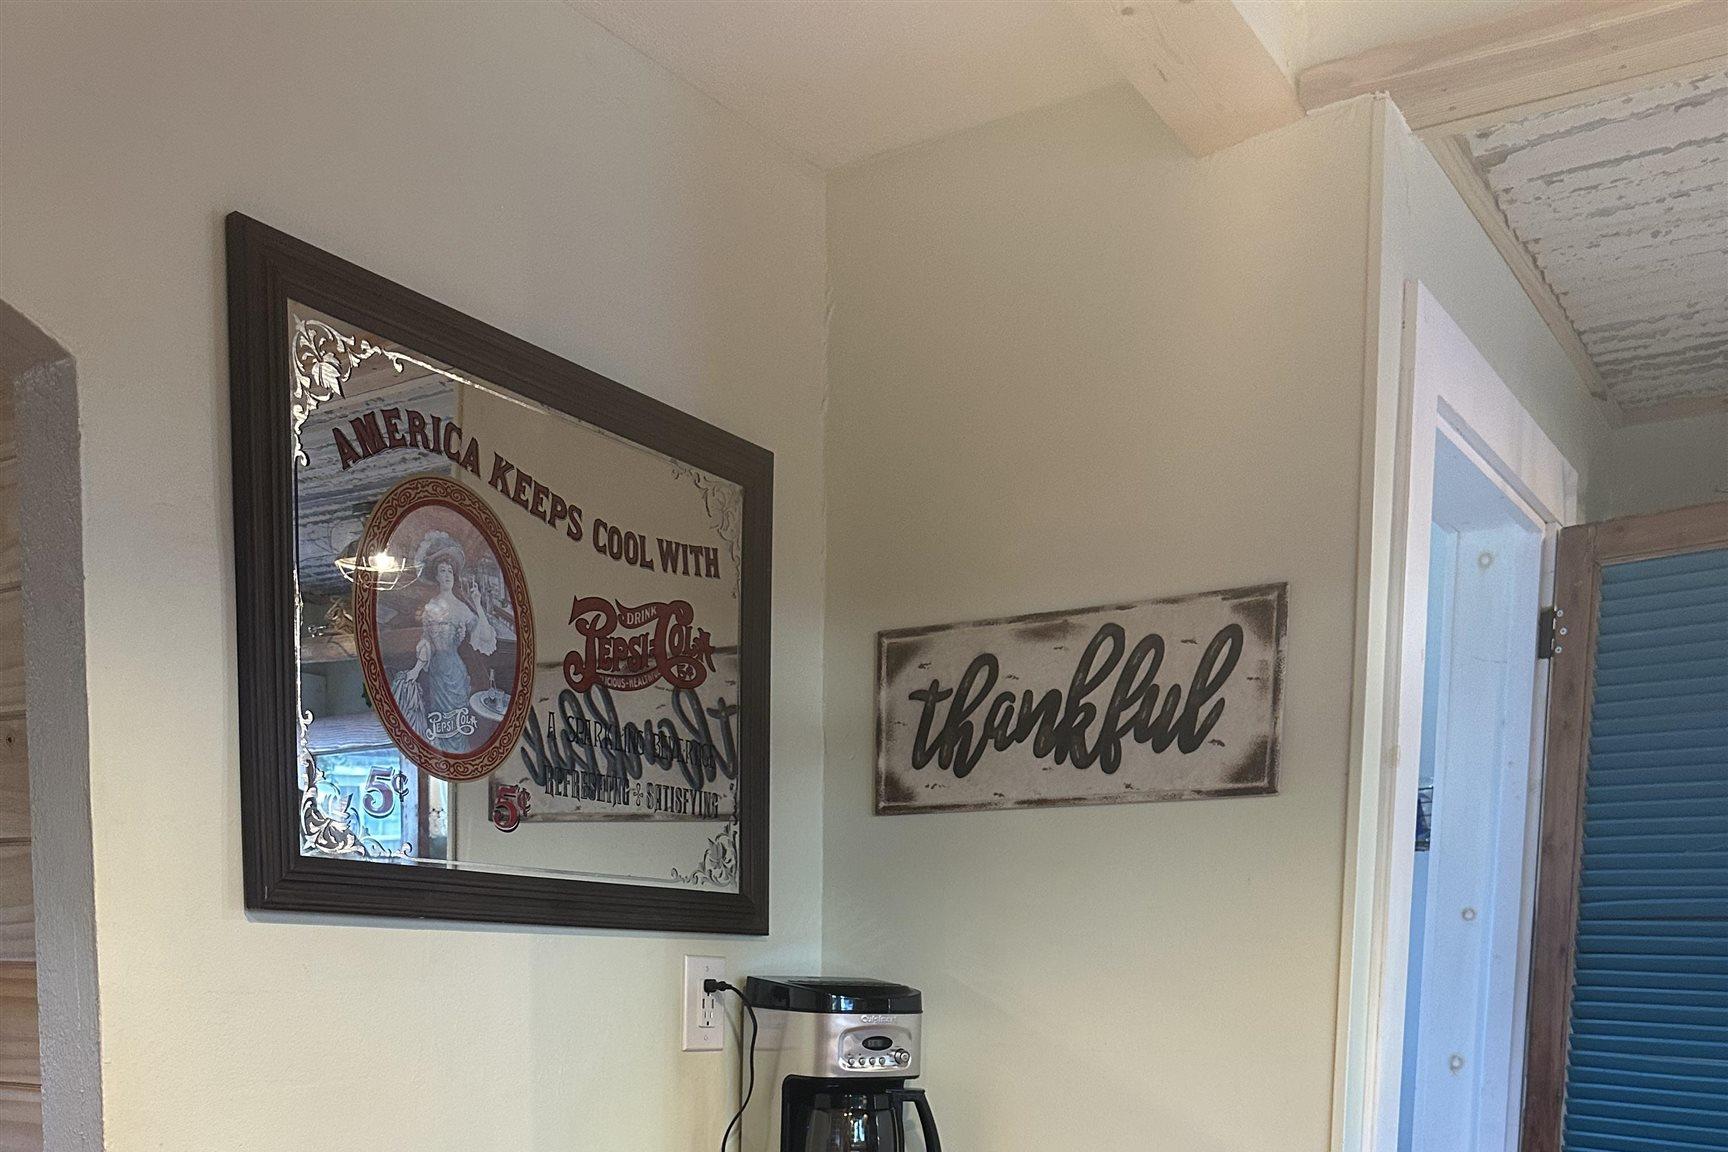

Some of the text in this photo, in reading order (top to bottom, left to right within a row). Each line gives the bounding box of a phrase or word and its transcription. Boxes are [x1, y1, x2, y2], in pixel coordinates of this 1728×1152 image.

[332, 407, 721, 580] AMERICA KEEPS COOL WITH
[626, 605, 657, 625] DRINK
[908, 622, 1244, 779] thankful
[547, 711, 557, 740] A
[493, 784, 531, 833] 5¢
[646, 782, 719, 819] SATISFYING
